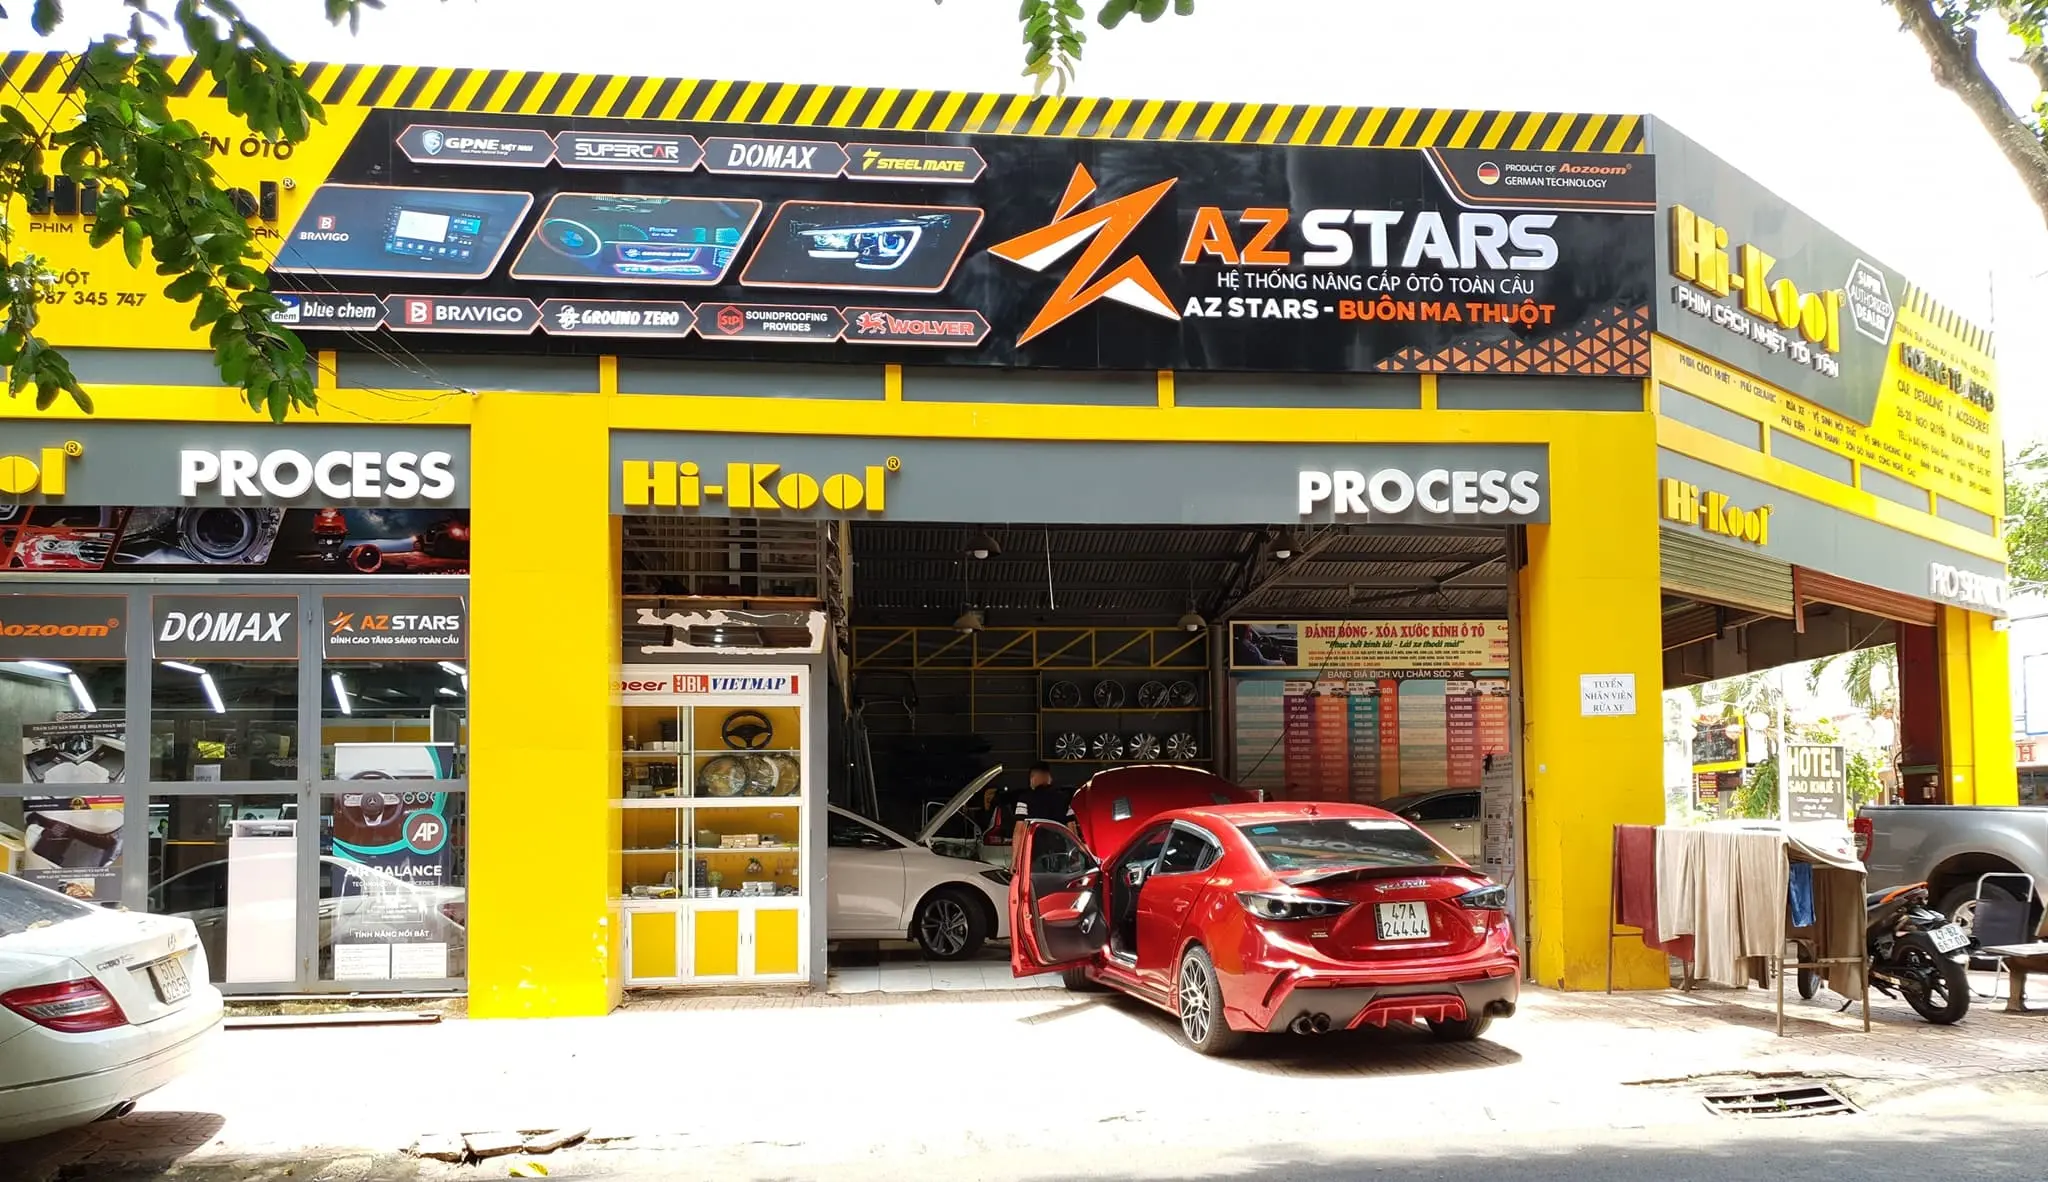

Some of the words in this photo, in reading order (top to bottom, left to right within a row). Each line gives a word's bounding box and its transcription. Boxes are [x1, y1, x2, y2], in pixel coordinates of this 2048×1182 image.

[445, 137, 500, 150] GPNE
[575, 143, 679, 159] SUPERCAR
[727, 143, 818, 169] DOMAX
[1505, 164, 1542, 173] PRODUCT
[1545, 164, 1556, 173] OF
[1559, 163, 1627, 175] Aozoom
[1505, 176, 1545, 187] GERMAN
[1546, 178, 1607, 188] TECHNOLOGY
[30, 222, 73, 233] PHIM
[300, 231, 349, 242] BRAVIGO
[1179, 206, 1290, 265] AZ
[1300, 209, 1559, 271] STARS
[1217, 269, 1240, 291] HỆ
[1244, 268, 1307, 289] THỐNG
[1312, 272, 1362, 291] NÂNG
[1367, 270, 1401, 292] CẤP
[1406, 273, 1444, 292] ÔTÔ
[1449, 275, 1495, 294] TOÀN
[1500, 273, 1534, 294] CẦU
[1669, 204, 1840, 352] Hi-Kool
[74, 292, 108, 306] 345
[116, 292, 147, 307] 747
[304, 302, 334, 318] blue
[338, 303, 376, 318] chem
[436, 305, 523, 322] BRAVIGO
[746, 310, 828, 321] SOUNDPROOFING
[1184, 297, 1222, 318] AZ
[1227, 297, 1319, 319] STARS
[1339, 293, 1415, 321] BUÔN
[1420, 302, 1462, 322] MA
[1465, 298, 1556, 329] THUỘT
[582, 311, 640, 326] GROUND
[643, 311, 679, 326] ZERO
[886, 313, 975, 336] WOLVER
[763, 322, 811, 332] PROVIDES
[1677, 285, 1711, 318] PHIM
[1714, 304, 1751, 337] CÁCH
[1753, 320, 1788, 355] NHIỆT
[1813, 351, 1839, 378] TÂN
[180, 449, 455, 499] PROCESS
[622, 460, 885, 511] Hi-Kool
[1299, 469, 1540, 515] PROCESS
[1661, 477, 1769, 546] Hi-Kool
[159, 611, 292, 642] DOMAX
[360, 615, 389, 630] AZ
[391, 615, 460, 630] STARS
[1305, 623, 1338, 638] ĐÁNH
[1338, 623, 1368, 638] BÓNG
[1375, 623, 1398, 638] XÓA
[1400, 623, 1430, 638] XƯỚC
[1432, 622, 1459, 638] KÍNH
[1461, 622, 1469, 638] Ô
[1470, 622, 1485, 638] TÔ
[352, 636, 370, 644] CAO
[395, 635, 418, 644] SÁNG
[1452, 670, 1465, 678] XE
[677, 675, 707, 693] JBL
[712, 677, 786, 691] VIETMAP
[1593, 677, 1623, 689] TUYỂN
[1585, 690, 1609, 700] NHÂN
[1612, 690, 1633, 700] VIÊN
[1614, 704, 1624, 712] XE
[1787, 746, 1841, 777] HOTEL
[1788, 780, 1808, 793] SAO
[412, 822, 439, 842] AP
[374, 865, 443, 877] BALANCE
[1392, 903, 1416, 920] 47A
[1383, 920, 1428, 938] 244.44
